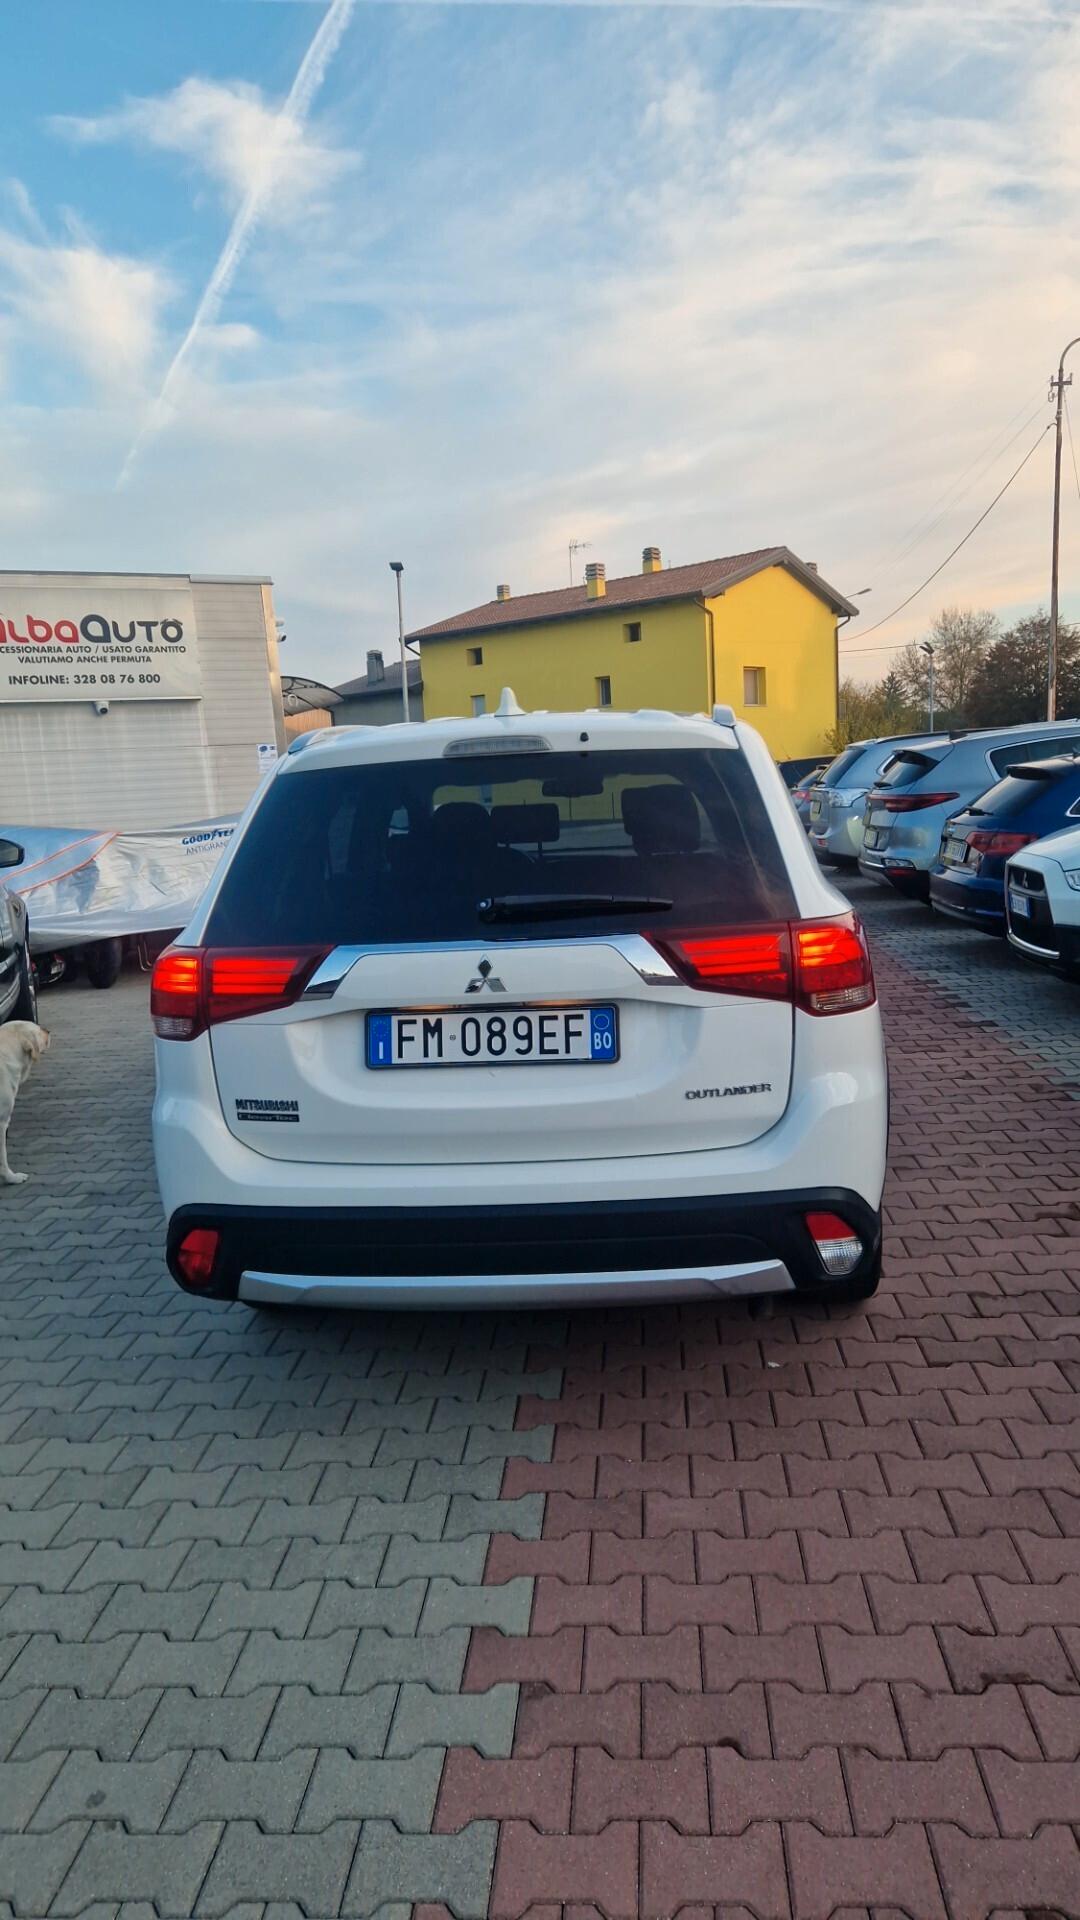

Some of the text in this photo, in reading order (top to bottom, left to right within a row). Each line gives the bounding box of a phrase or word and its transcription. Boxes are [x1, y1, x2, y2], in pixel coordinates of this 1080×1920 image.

[66, 645, 92, 654] AUTO
[102, 645, 132, 653] USATO
[135, 645, 186, 653] GARANTITO
[18, 656, 73, 664] VALUTIAMO
[8, 673, 161, 685] INFOLINE: 328 08 76 800
[397, 1017, 443, 1059] FM
[460, 1013, 585, 1057] 089EF
[593, 1031, 612, 1050] BO
[685, 1083, 772, 1100] OUTLANDER
